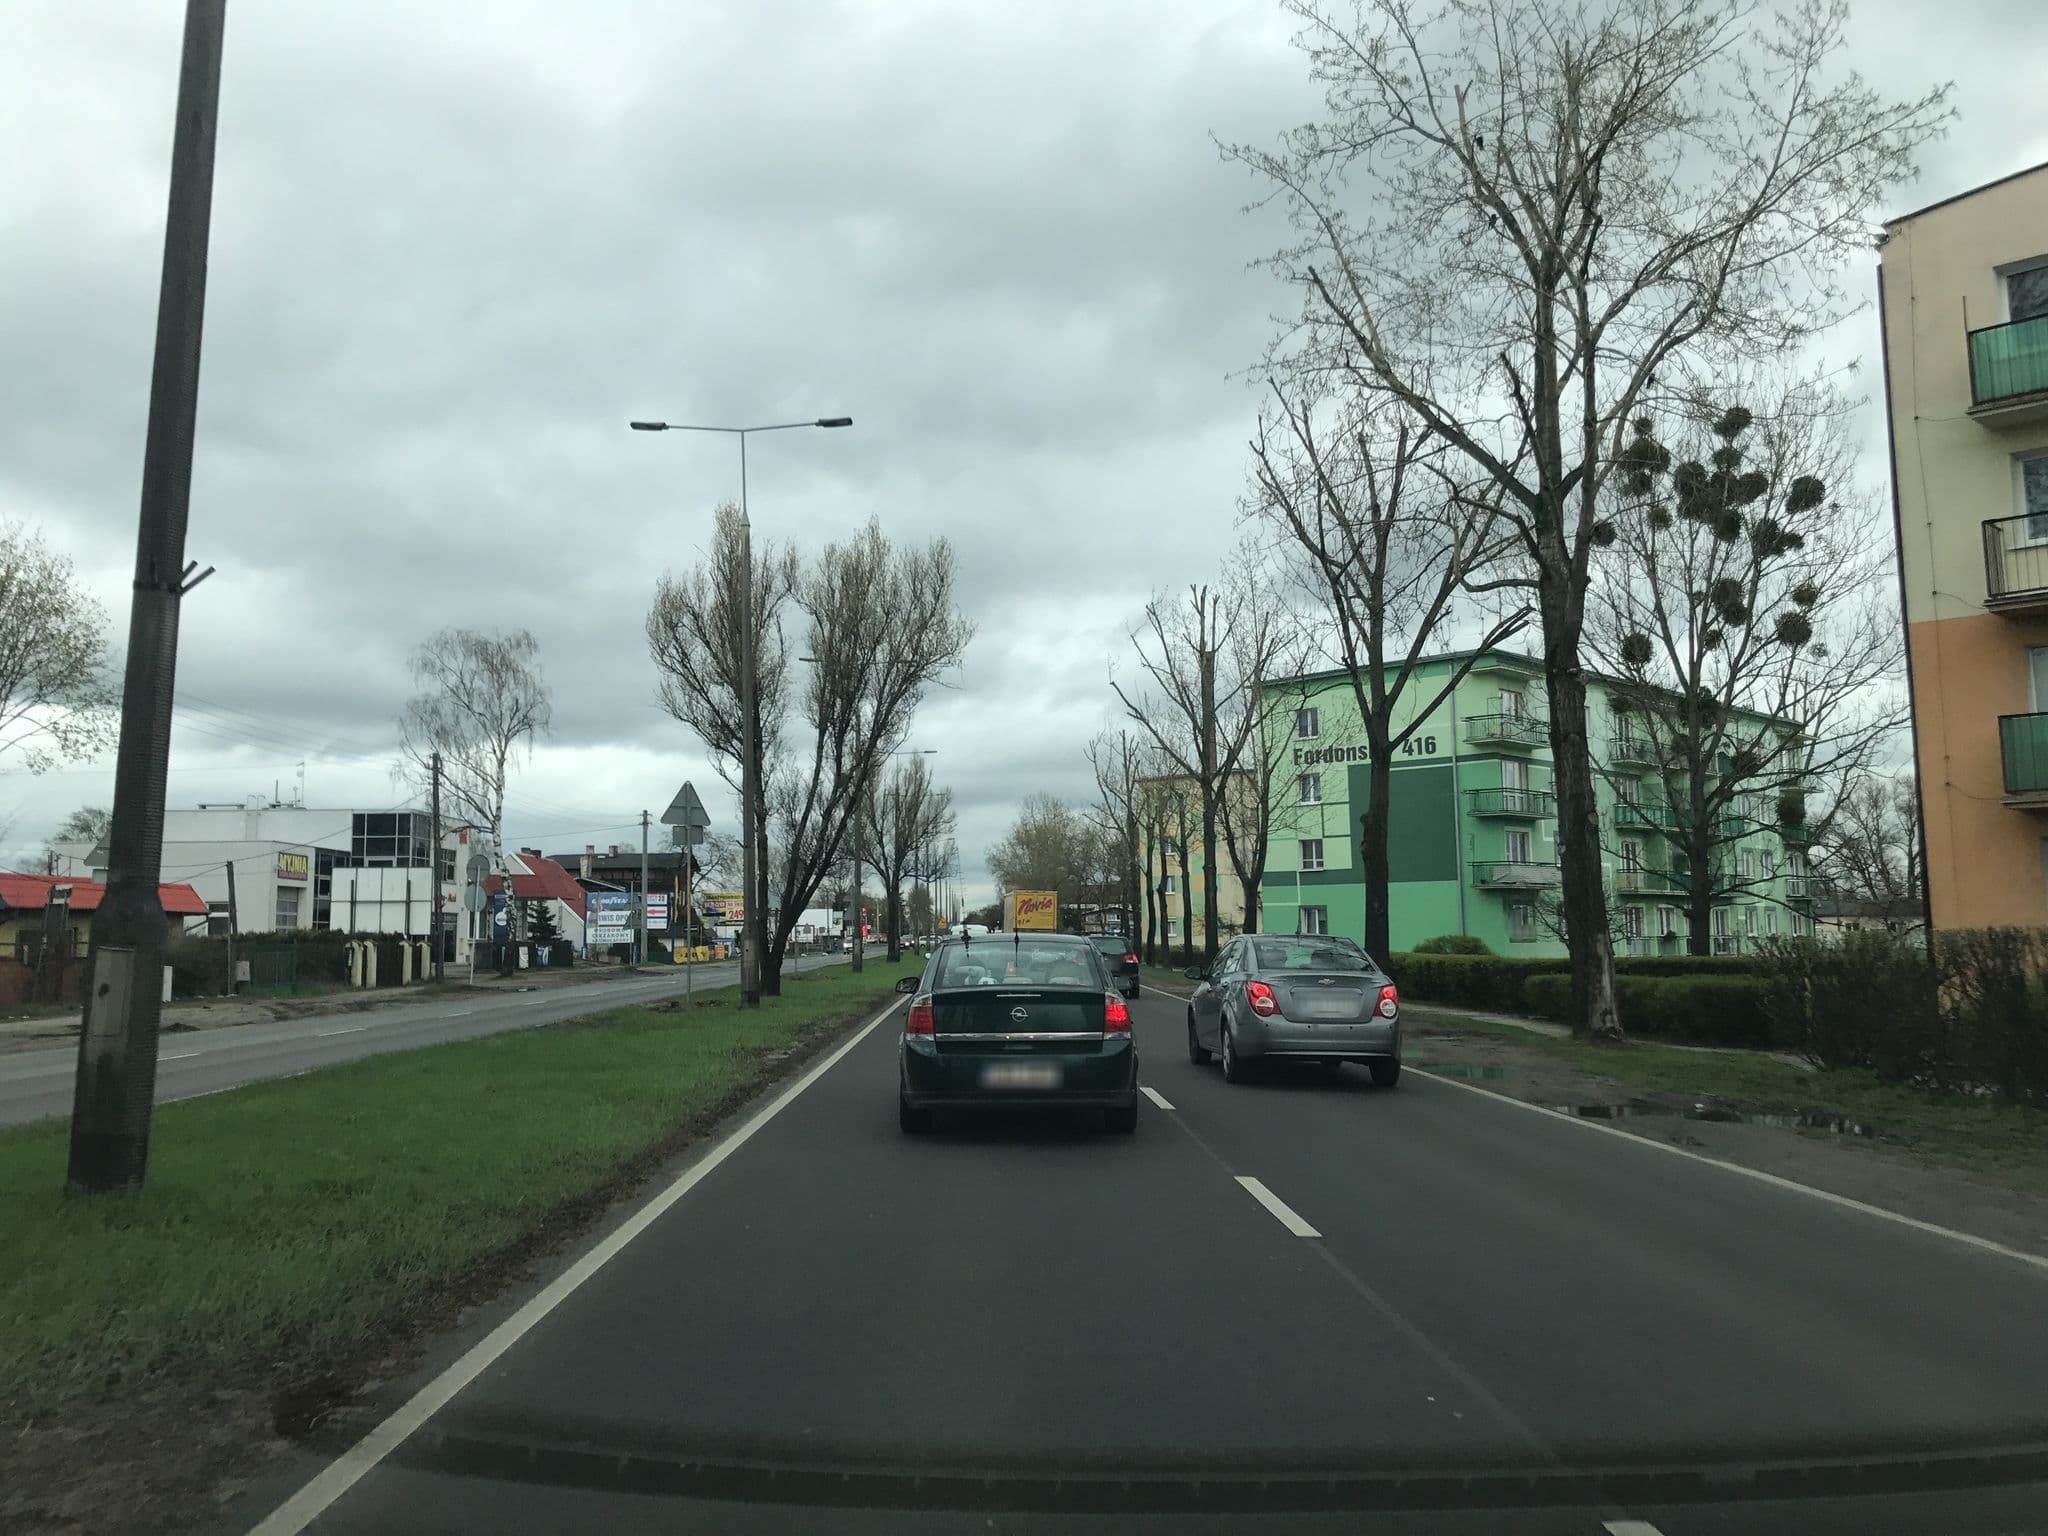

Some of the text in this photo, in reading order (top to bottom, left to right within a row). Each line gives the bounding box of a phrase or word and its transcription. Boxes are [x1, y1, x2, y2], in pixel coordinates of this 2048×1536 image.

[1293, 736, 1437, 766] Fordons 416
[279, 854, 307, 873] MYJNIA
[591, 896, 629, 905] GODYEA
